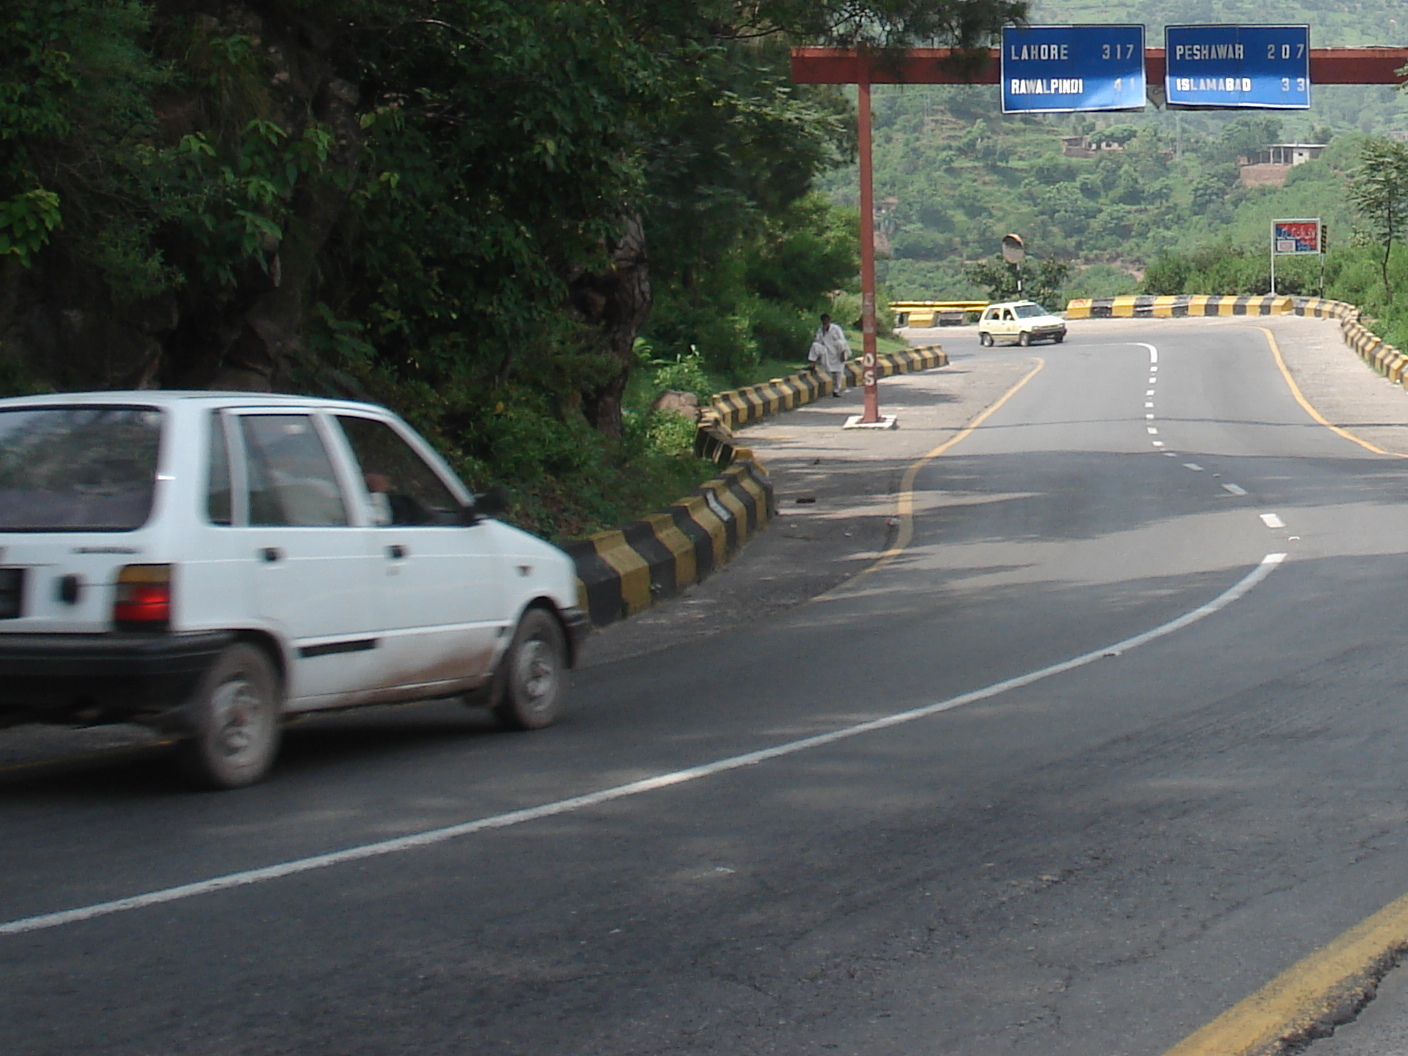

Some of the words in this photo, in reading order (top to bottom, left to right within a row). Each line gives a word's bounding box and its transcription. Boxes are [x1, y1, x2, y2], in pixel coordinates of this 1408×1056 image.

[1011, 45, 1069, 60] LAHORE
[1102, 45, 1134, 59] 317
[1175, 44, 1244, 60] PESHAWAR
[1266, 43, 1305, 59] 207
[1010, 77, 1084, 94] RAWALPINDI
[1114, 78, 1136, 91] 41
[1175, 77, 1252, 92] ISLAMABAD
[1281, 77, 1306, 92] 33
